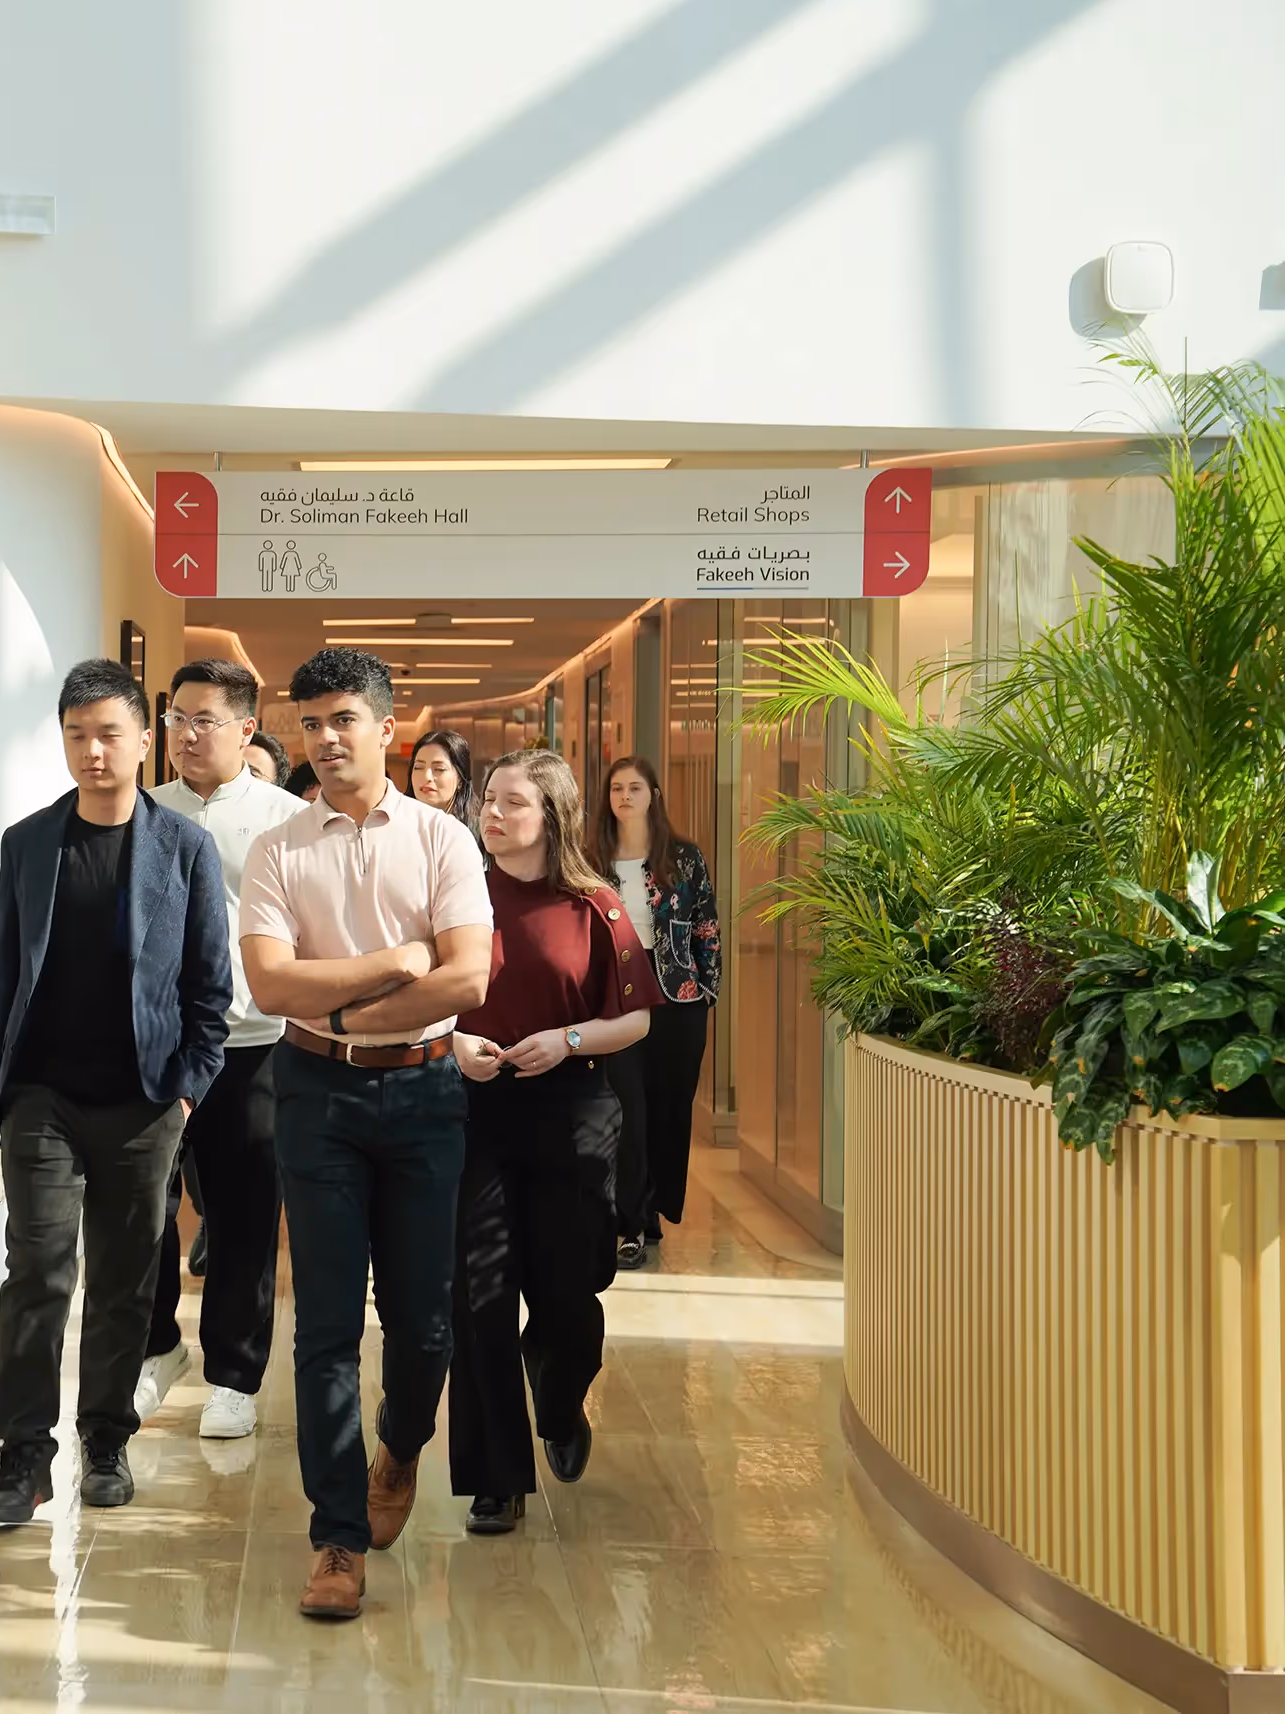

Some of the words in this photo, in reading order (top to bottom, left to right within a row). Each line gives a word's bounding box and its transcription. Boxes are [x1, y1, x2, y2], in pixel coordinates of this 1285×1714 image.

[260, 488, 297, 505] فقيه
[301, 488, 359, 506] سليمان
[379, 488, 415, 502] قاعة
[760, 485, 810, 504] المتاجر
[260, 508, 284, 524] Dr.
[290, 508, 360, 524] Soliman
[366, 508, 428, 524] Fakeeh
[434, 508, 469, 524] Hall
[697, 507, 748, 523] Retail
[754, 507, 810, 525] Shops
[697, 546, 741, 563] فقيه
[747, 546, 810, 563] بصريات
[696, 567, 754, 582] Fakeeh
[759, 567, 810, 582] Vision
